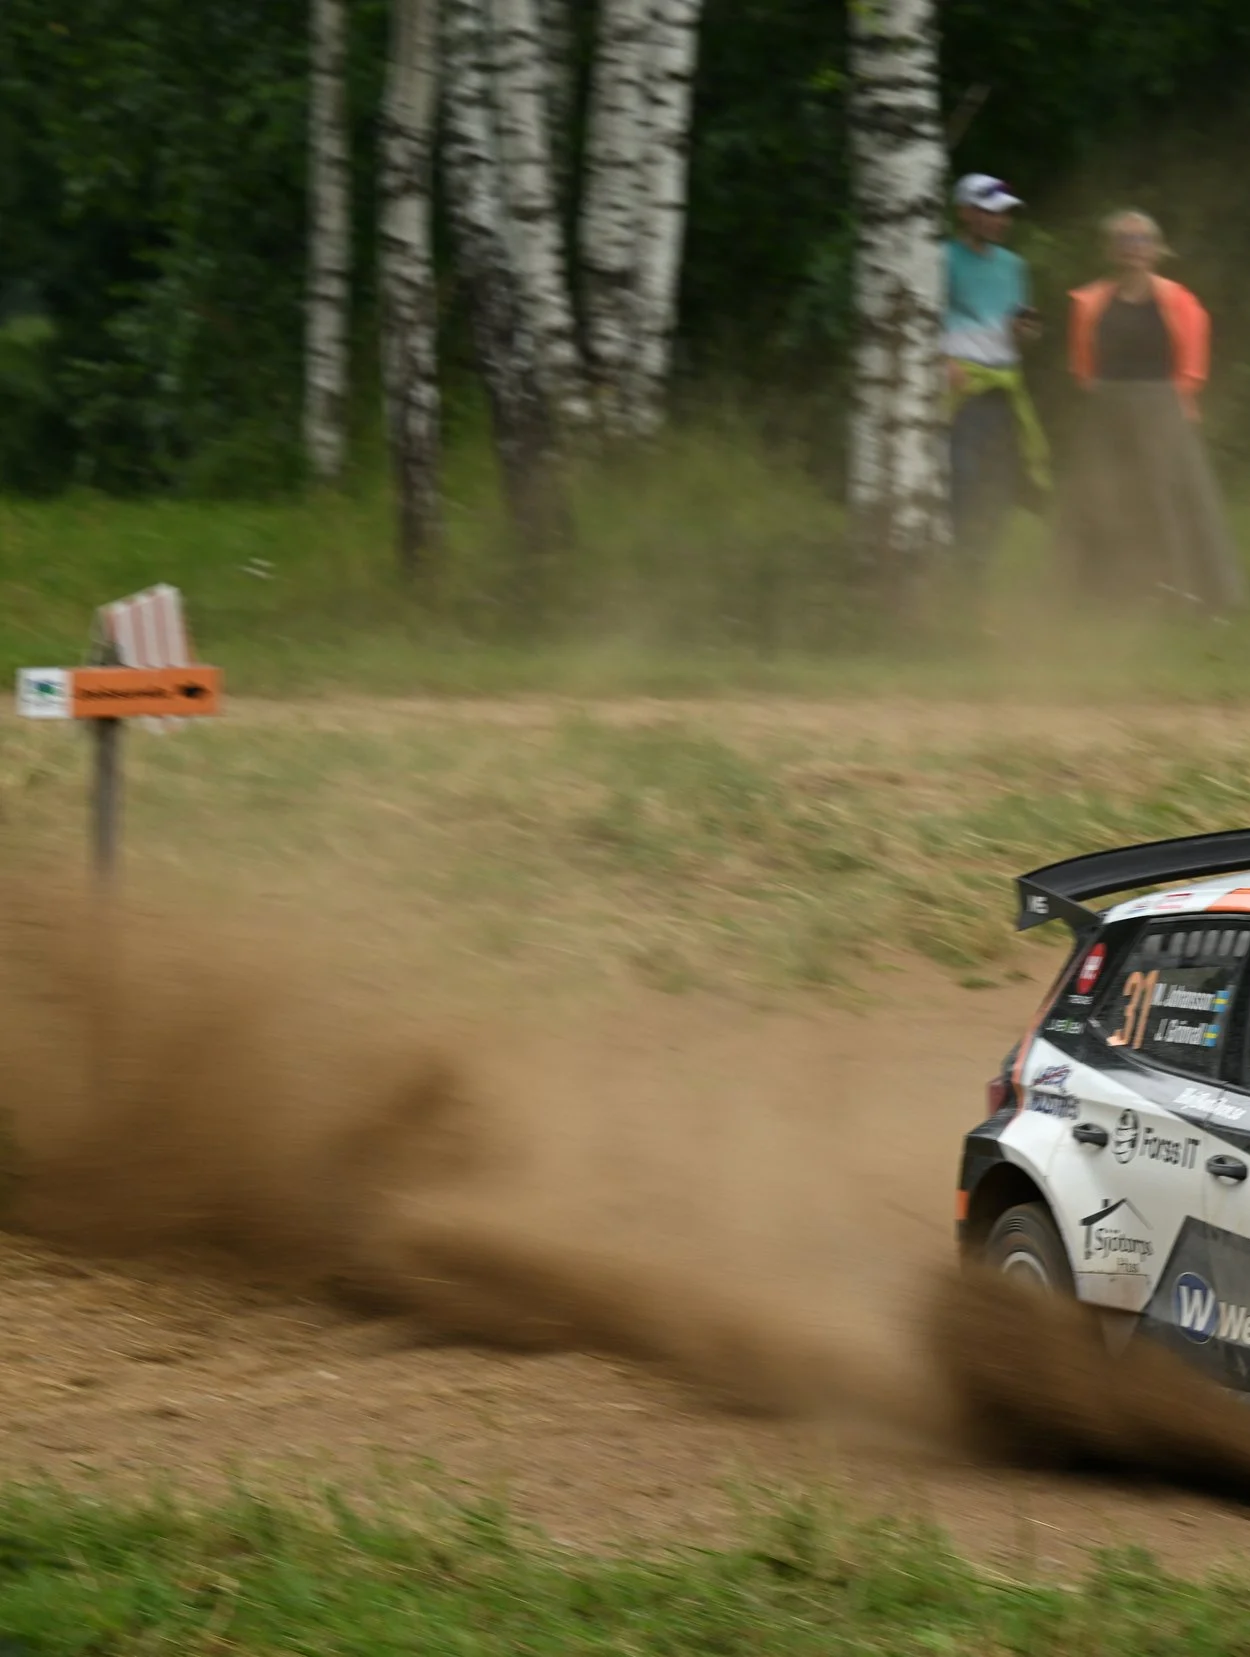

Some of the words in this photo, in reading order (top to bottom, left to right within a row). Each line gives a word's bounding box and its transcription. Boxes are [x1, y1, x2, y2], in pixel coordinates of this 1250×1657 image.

[1106, 969, 1161, 1050] 31
[1139, 1127, 1181, 1165] Forss
[1181, 1136, 1200, 1169] IT
[1179, 1285, 1216, 1332] W
